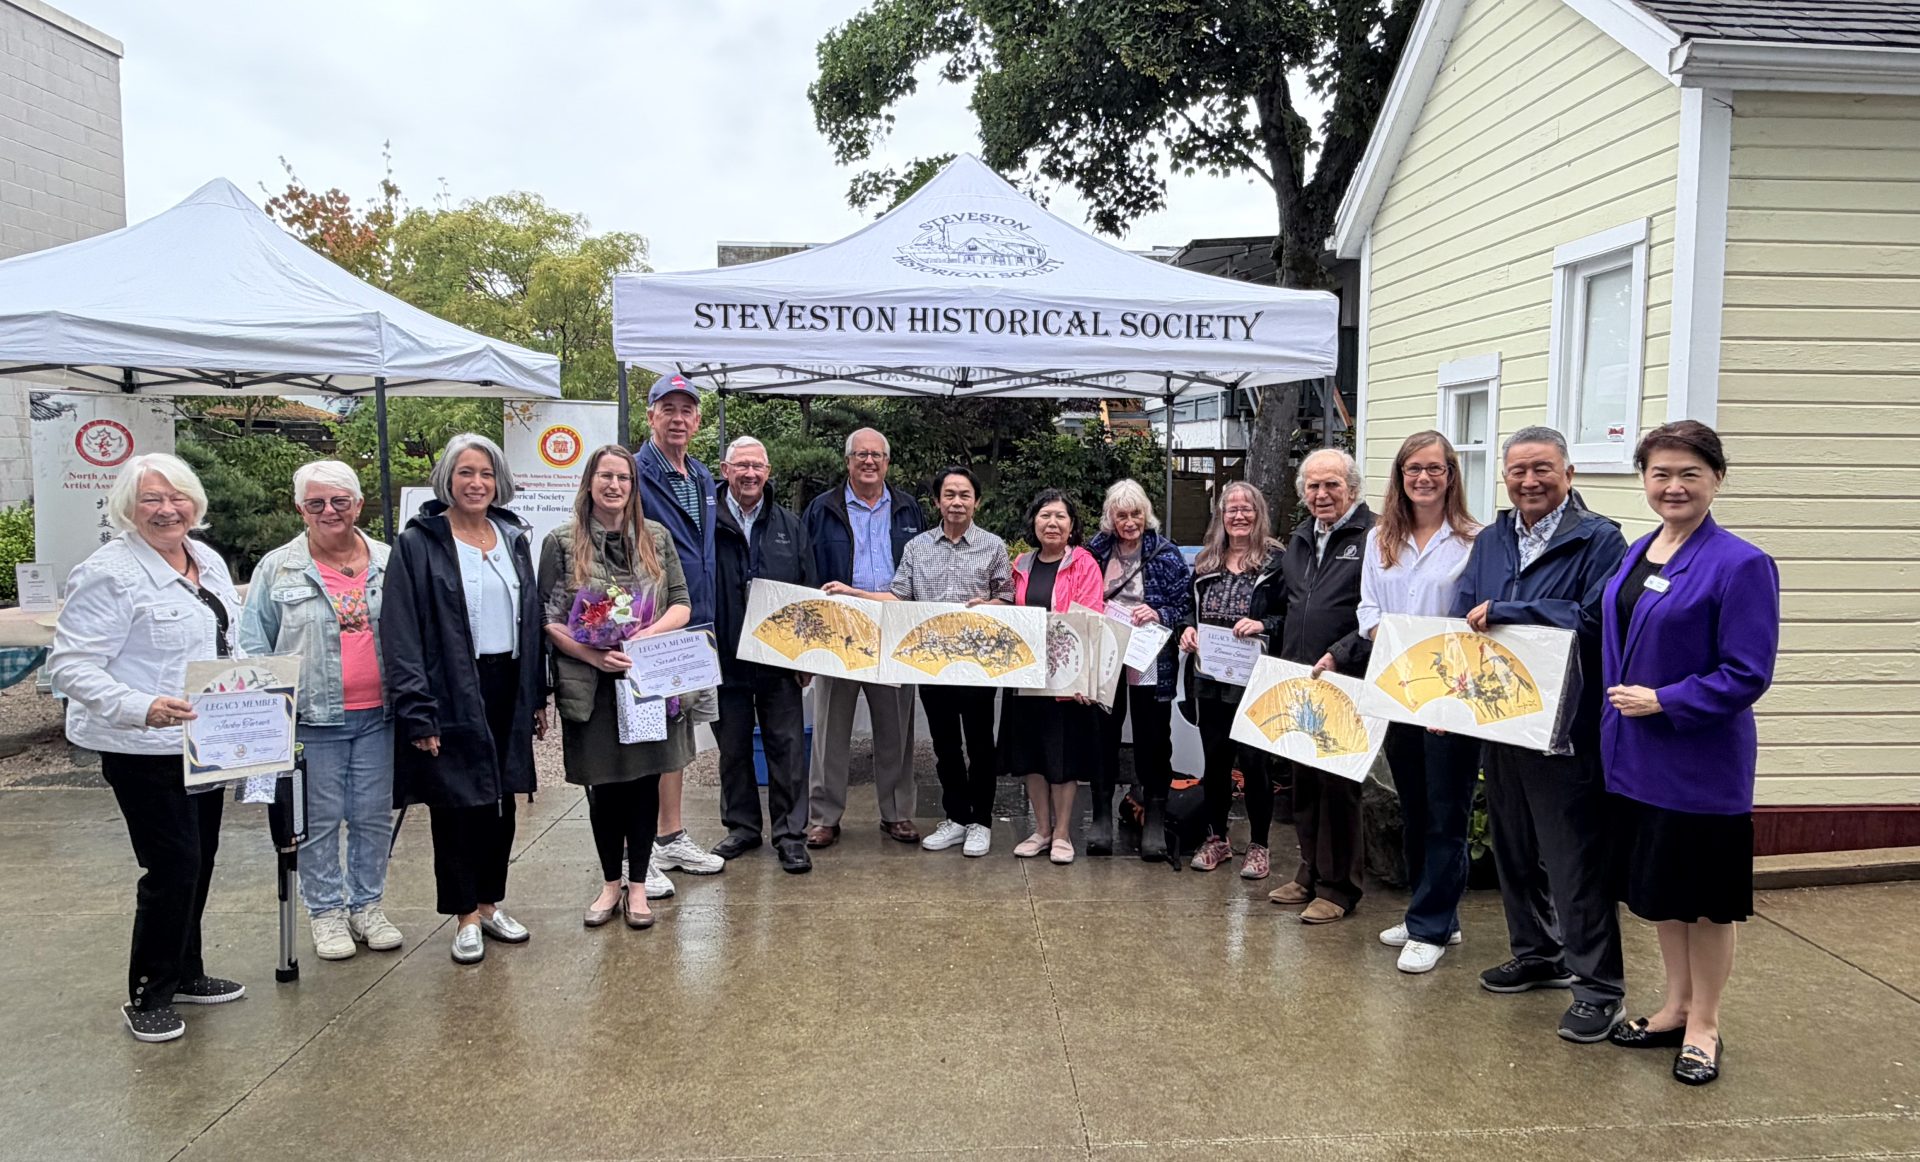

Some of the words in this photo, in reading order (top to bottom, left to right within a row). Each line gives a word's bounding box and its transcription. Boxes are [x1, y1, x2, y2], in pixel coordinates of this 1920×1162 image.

[918, 212, 1032, 233] STEVESTON
[892, 255, 995, 279] HISTORICAL
[999, 258, 1065, 279] SOCIETY
[694, 300, 897, 333] STEVESTON
[907, 307, 1112, 337] HISTORICAL
[1119, 310, 1265, 342] SOCIETY
[69, 472, 98, 480] North
[101, 472, 118, 480] Am
[62, 482, 92, 490] Artist
[513, 492, 536, 500] orical
[537, 493, 566, 502] Society
[523, 504, 535, 512] the
[536, 504, 574, 513] Following
[639, 643, 667, 653] LEGACY
[669, 635, 700, 646] MEMBER
[205, 701, 239, 711] LEGACY
[242, 698, 278, 708] MEMBER
